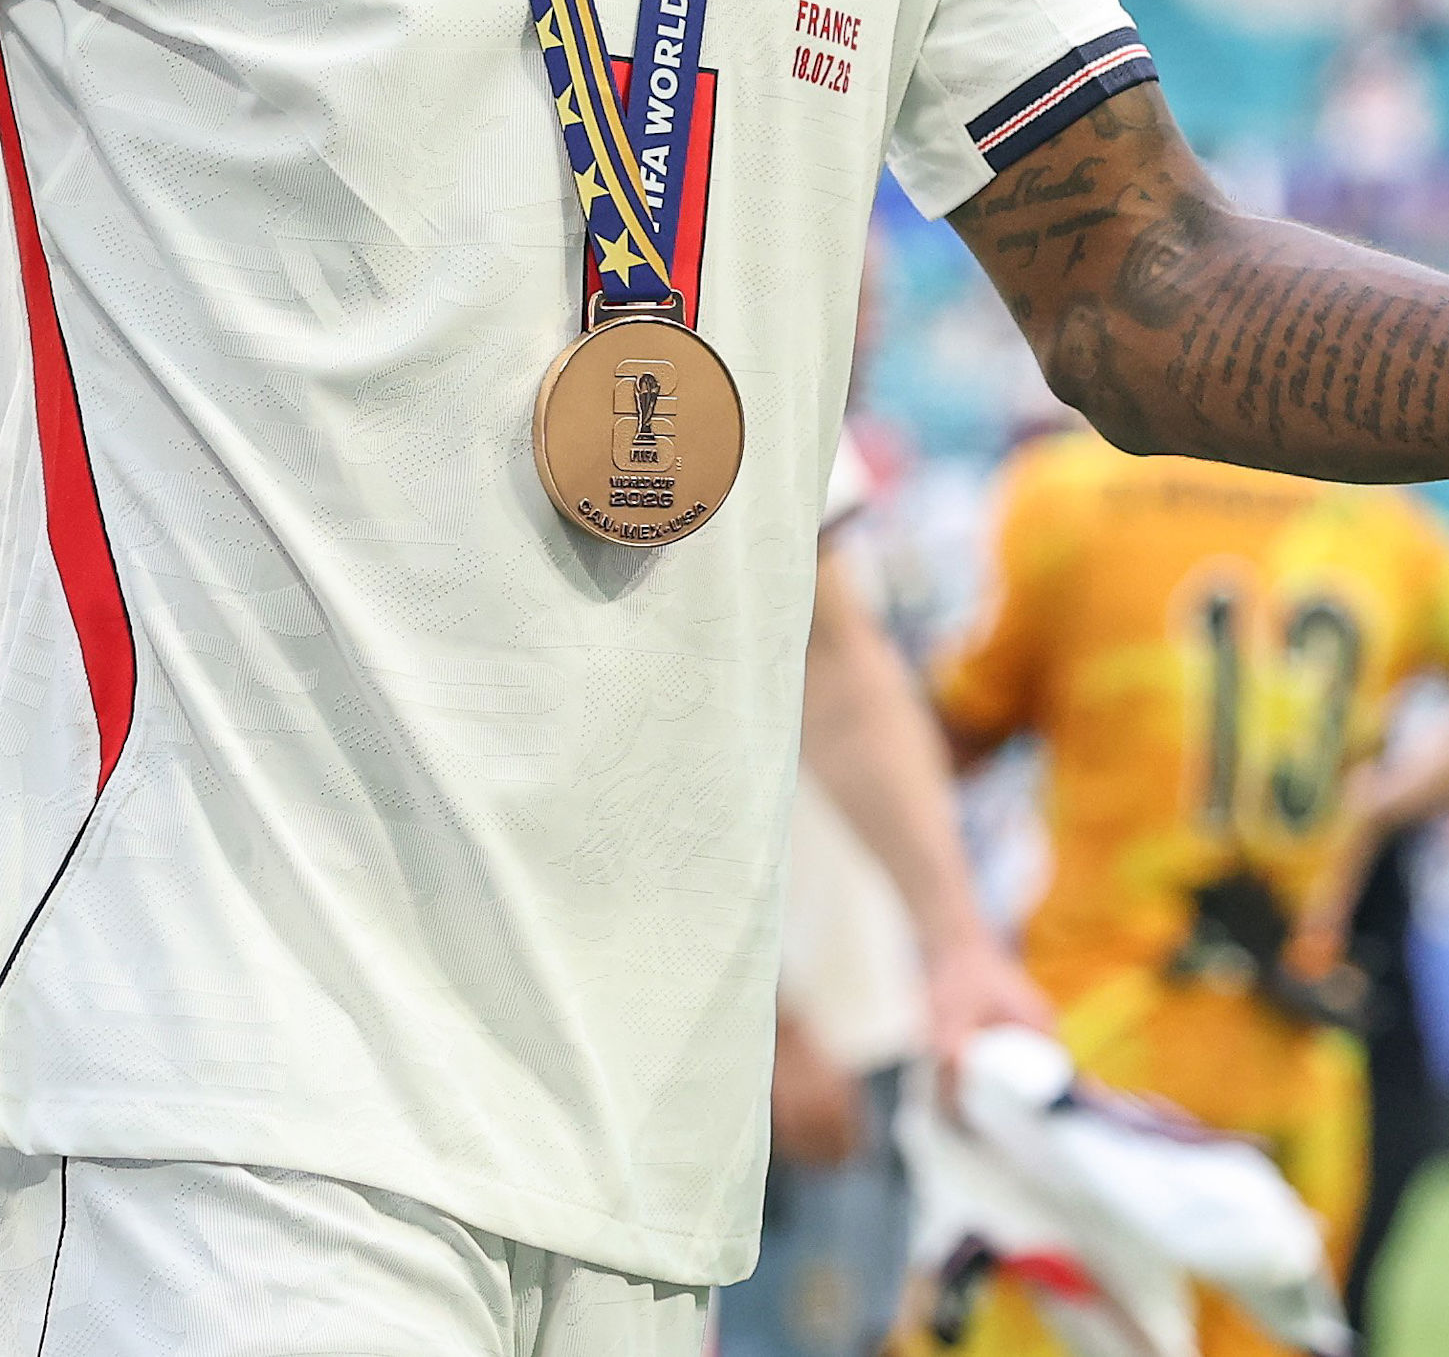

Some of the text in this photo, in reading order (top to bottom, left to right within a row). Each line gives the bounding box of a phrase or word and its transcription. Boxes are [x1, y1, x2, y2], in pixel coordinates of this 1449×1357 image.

[791, 44, 852, 95] 18.07.26
[640, 144, 671, 234] IFA
[629, 448, 660, 464] FIFA
[609, 475, 676, 489] WORLD CUP
[609, 489, 674, 509] 2026
